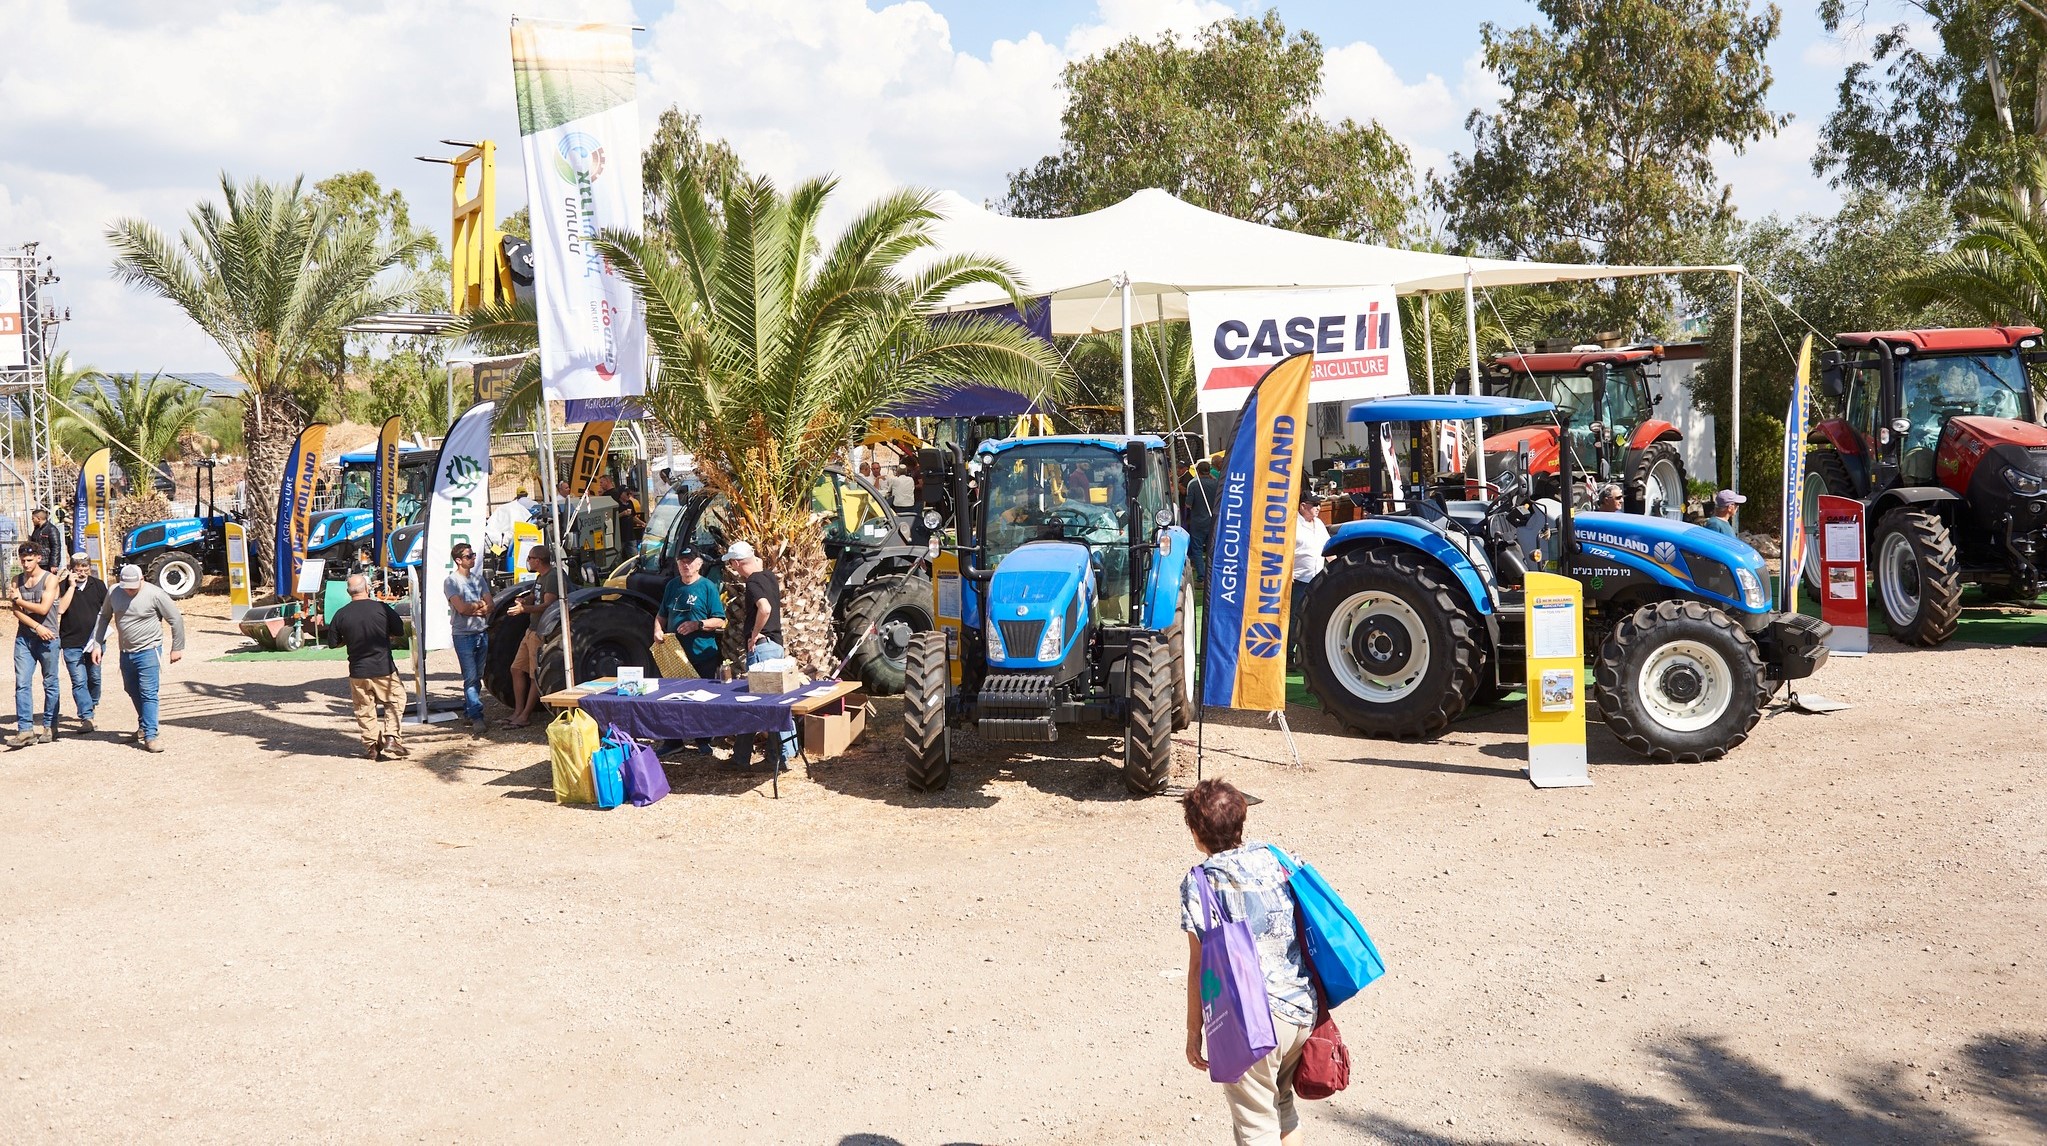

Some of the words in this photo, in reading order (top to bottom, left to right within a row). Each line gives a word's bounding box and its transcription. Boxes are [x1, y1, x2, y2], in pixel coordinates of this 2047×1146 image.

[565, 197, 580, 255] תערוכת
[1213, 314, 1346, 361] CASE
[1309, 358, 1385, 379] GRICULTURE
[298, 451, 317, 519] HOLLAND
[387, 443, 396, 500] HOLLAND
[1262, 415, 1296, 545] HOLLAND
[386, 502, 394, 531] NEW
[451, 496, 473, 527] ניו
[293, 518, 305, 553] NEW
[1220, 472, 1246, 604] AGRICULTURE
[1574, 529, 1597, 541] NEW
[1598, 532, 1650, 554] HOLLAND
[1257, 550, 1284, 615] NEW
[1595, 566, 1619, 577] פלדמן
[1620, 568, 1631, 577] ניו
